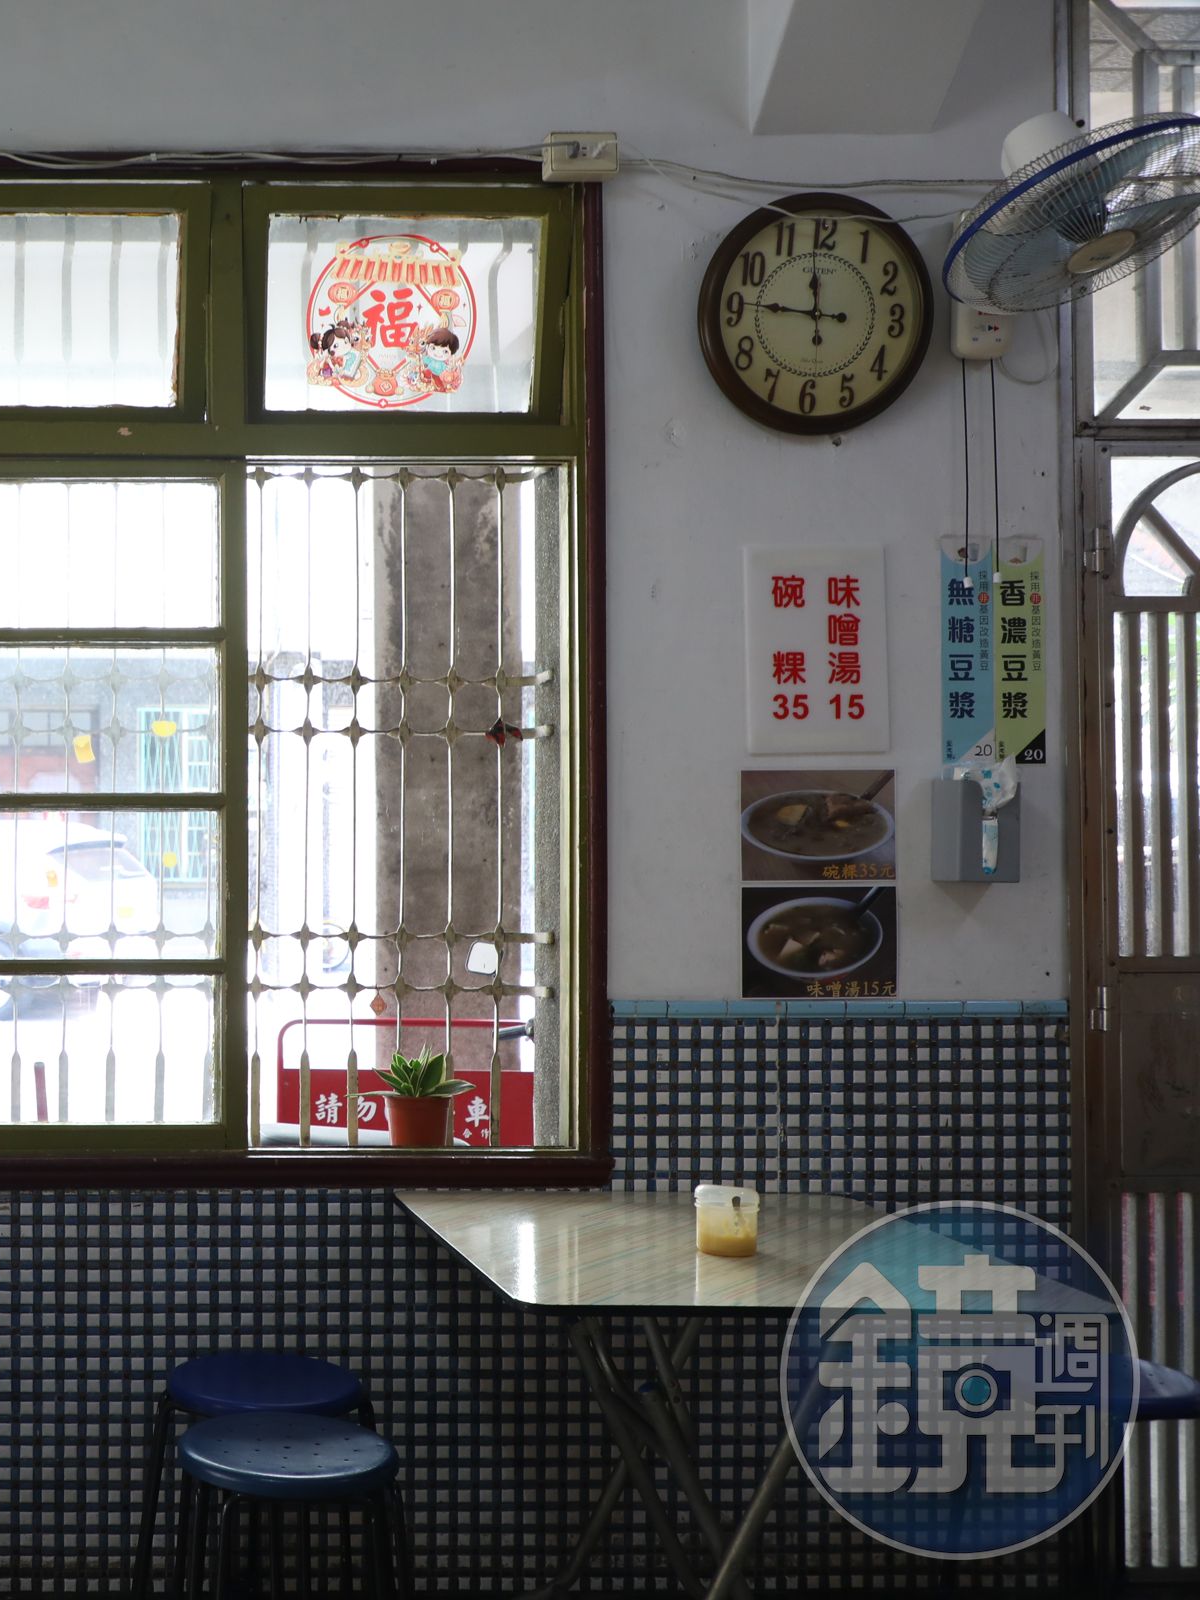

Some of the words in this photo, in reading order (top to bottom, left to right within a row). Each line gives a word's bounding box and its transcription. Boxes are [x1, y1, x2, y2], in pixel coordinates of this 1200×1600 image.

[775, 222, 796, 257] 11
[813, 218, 837, 250] 12
[859, 229, 869, 264] 1
[740, 251, 765, 286] 10
[880, 261, 898, 296] 2
[362, 288, 418, 348] 福
[726, 292, 744, 327] 9
[888, 303, 905, 338] 3
[735, 336, 754, 371] 8
[870, 344, 888, 381] 4
[765, 368, 780, 403] 7
[799, 379, 816, 414] 6
[838, 373, 854, 408] 5
[947, 578, 975, 719] 無糖豆漿
[999, 579, 1028, 719] 香濃豆漿
[772, 694, 809, 720] 35
[829, 694, 865, 720] 15
[974, 744, 993, 757] 20
[1024, 748, 1043, 761] 20
